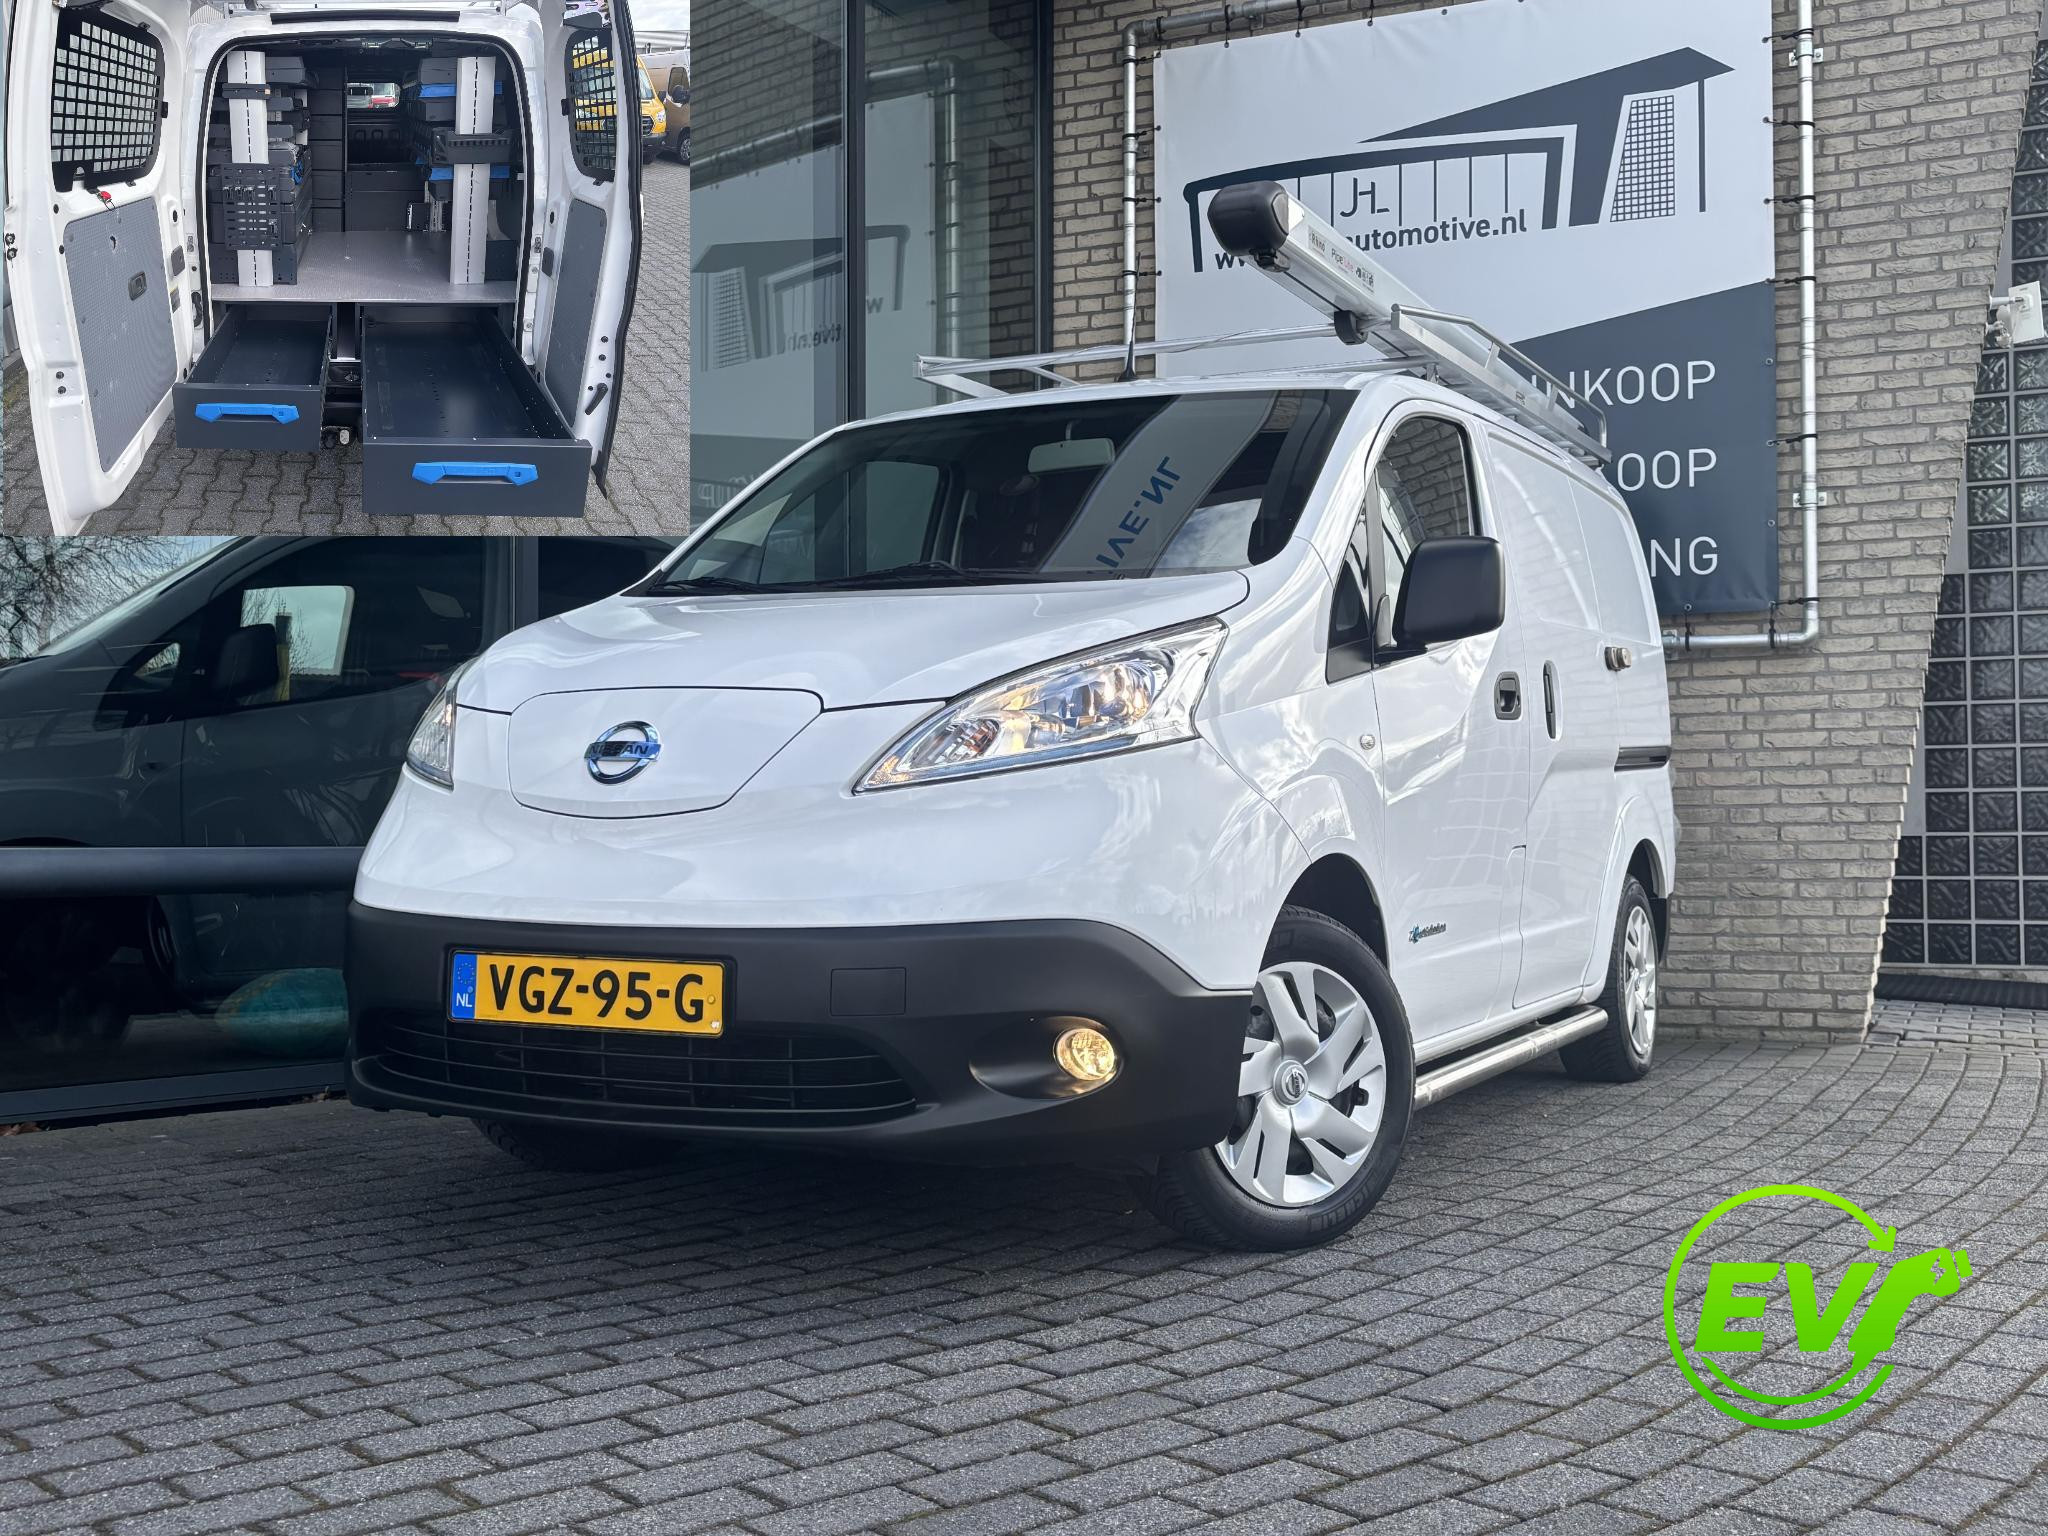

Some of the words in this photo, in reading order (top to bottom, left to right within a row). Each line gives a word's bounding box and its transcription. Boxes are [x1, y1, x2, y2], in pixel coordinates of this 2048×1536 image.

[1345, 209, 1527, 252] utomotive.nl
[1617, 448, 1717, 491] OOP
[1650, 536, 1718, 577] NG
[455, 992, 473, 1008] NL
[489, 963, 705, 1023] VGZ-95-G
